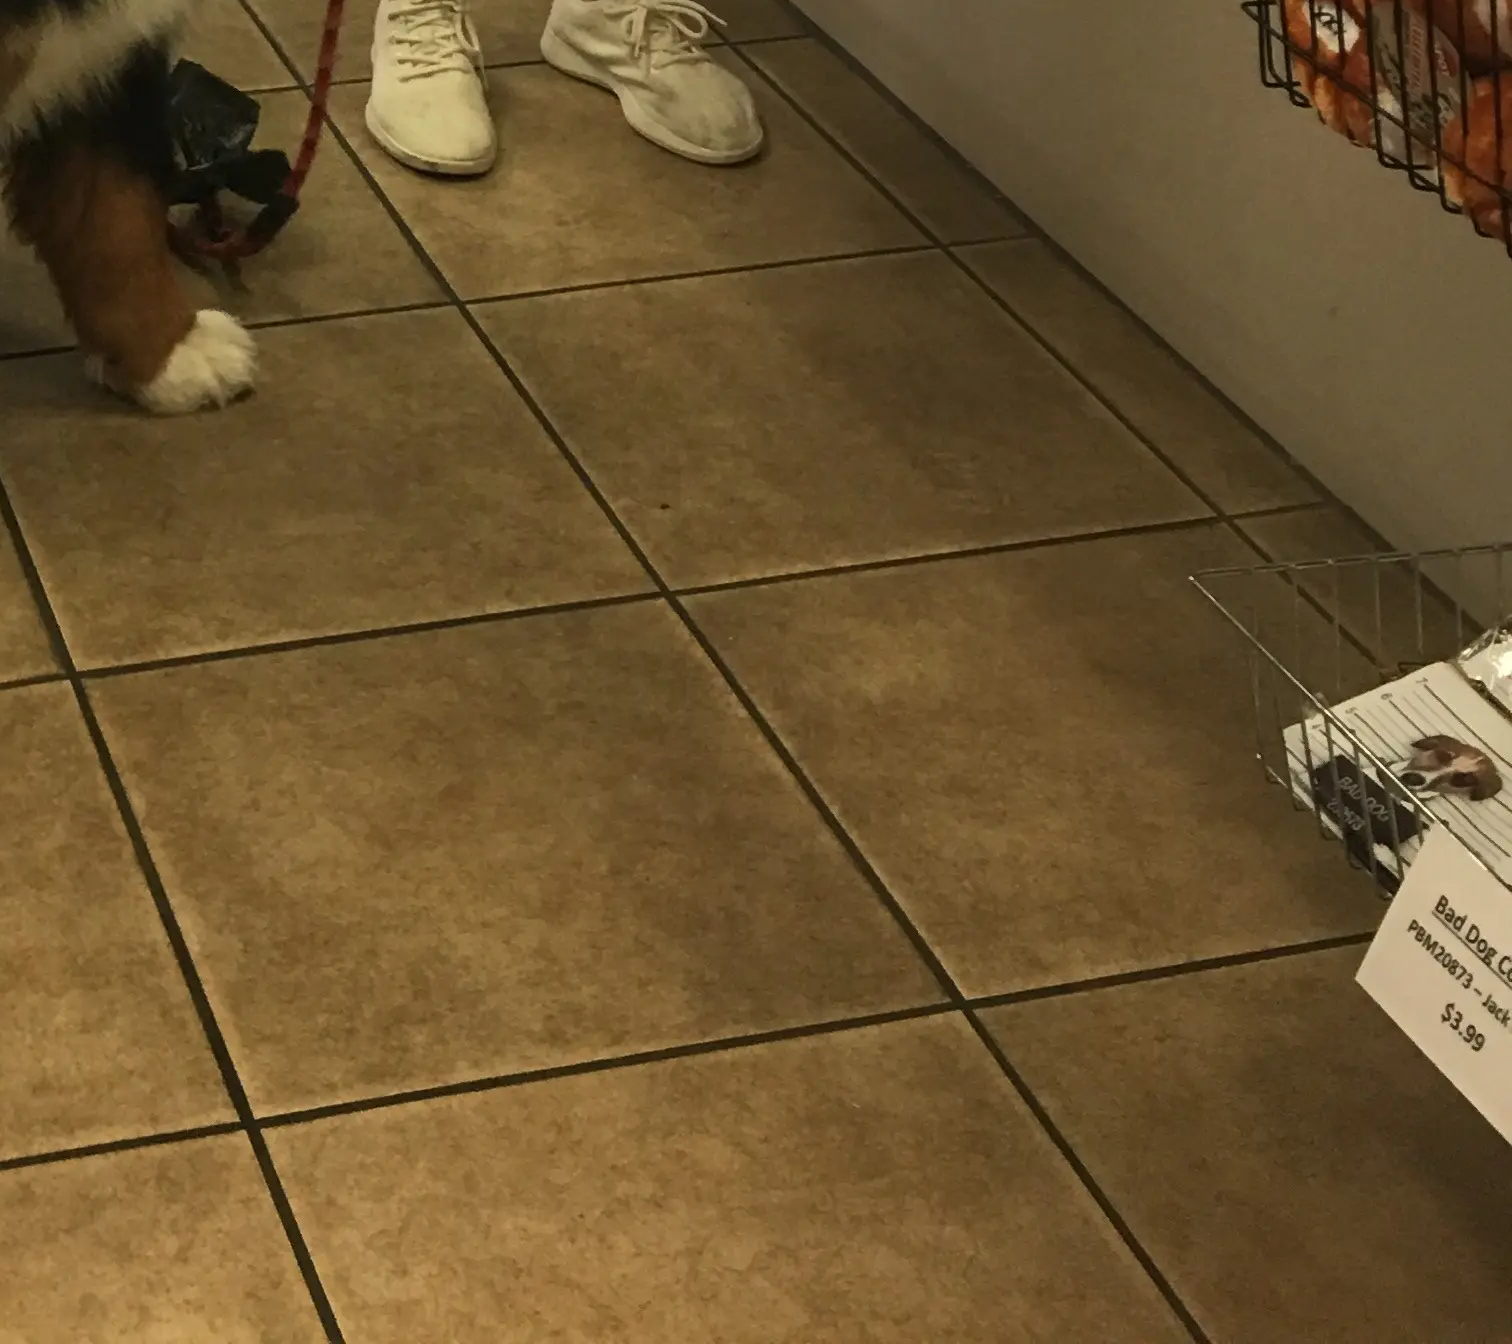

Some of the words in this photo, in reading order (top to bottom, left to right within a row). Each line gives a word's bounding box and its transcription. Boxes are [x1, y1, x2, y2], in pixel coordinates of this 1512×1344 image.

[1433, 894, 1468, 933] Bad
[1464, 923, 1498, 968] Dog
[1407, 918, 1475, 990] PBM20873
[1482, 994, 1511, 1028] Jack
[1441, 1002, 1487, 1052] $3.99
